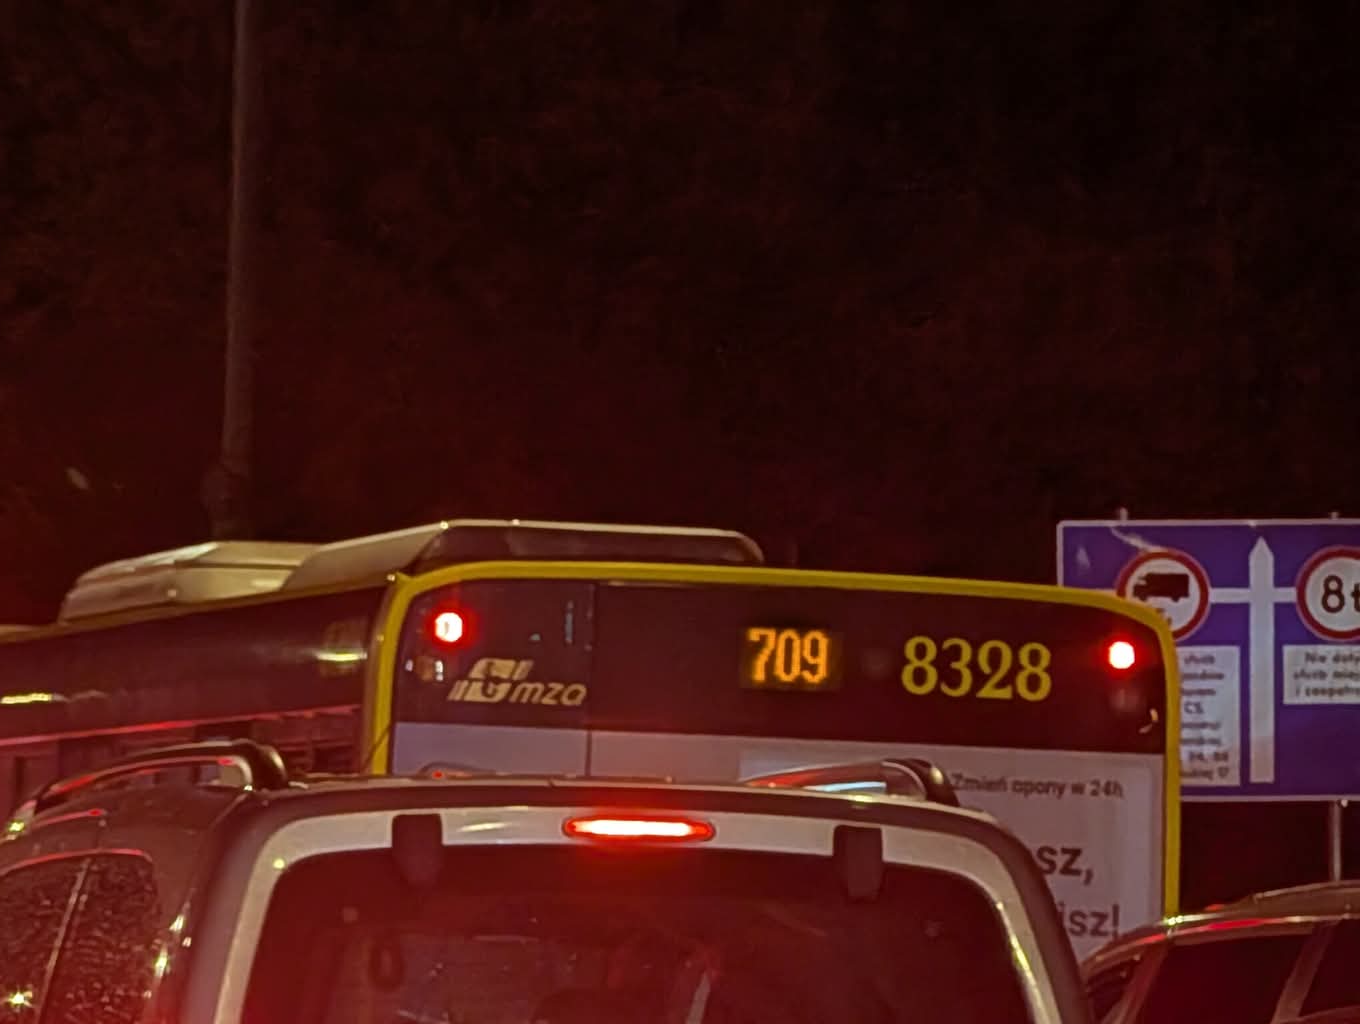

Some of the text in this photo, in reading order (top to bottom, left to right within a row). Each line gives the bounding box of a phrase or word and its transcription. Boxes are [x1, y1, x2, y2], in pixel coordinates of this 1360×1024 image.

[748, 627, 829, 683] 709
[901, 636, 1051, 701] 8328
[951, 772, 1124, 799] Zmień opony w 24h
